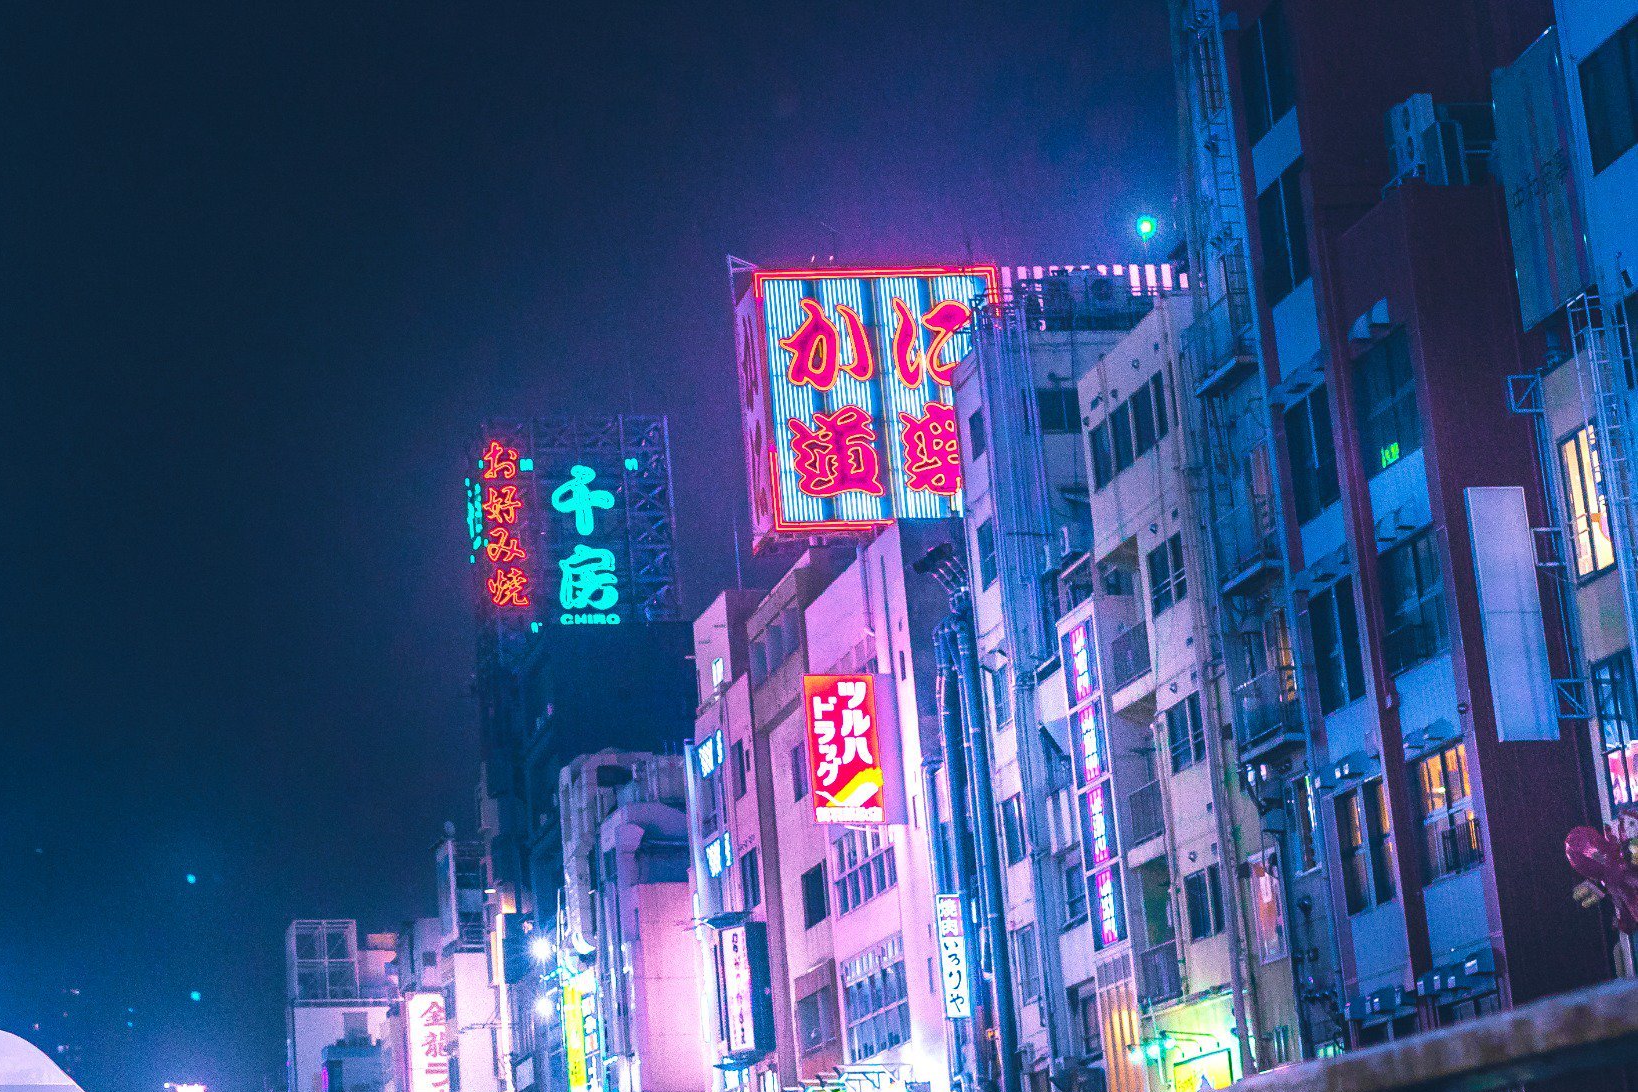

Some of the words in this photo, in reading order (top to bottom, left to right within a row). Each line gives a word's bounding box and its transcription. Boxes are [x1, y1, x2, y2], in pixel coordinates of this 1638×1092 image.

[779, 297, 973, 391] かに
[483, 439, 530, 607] お好み焼
[551, 464, 619, 611] 千房
[812, 696, 842, 787] ドラッグ
[837, 682, 873, 765] ツルハ
[944, 941, 965, 1013] いろりや
